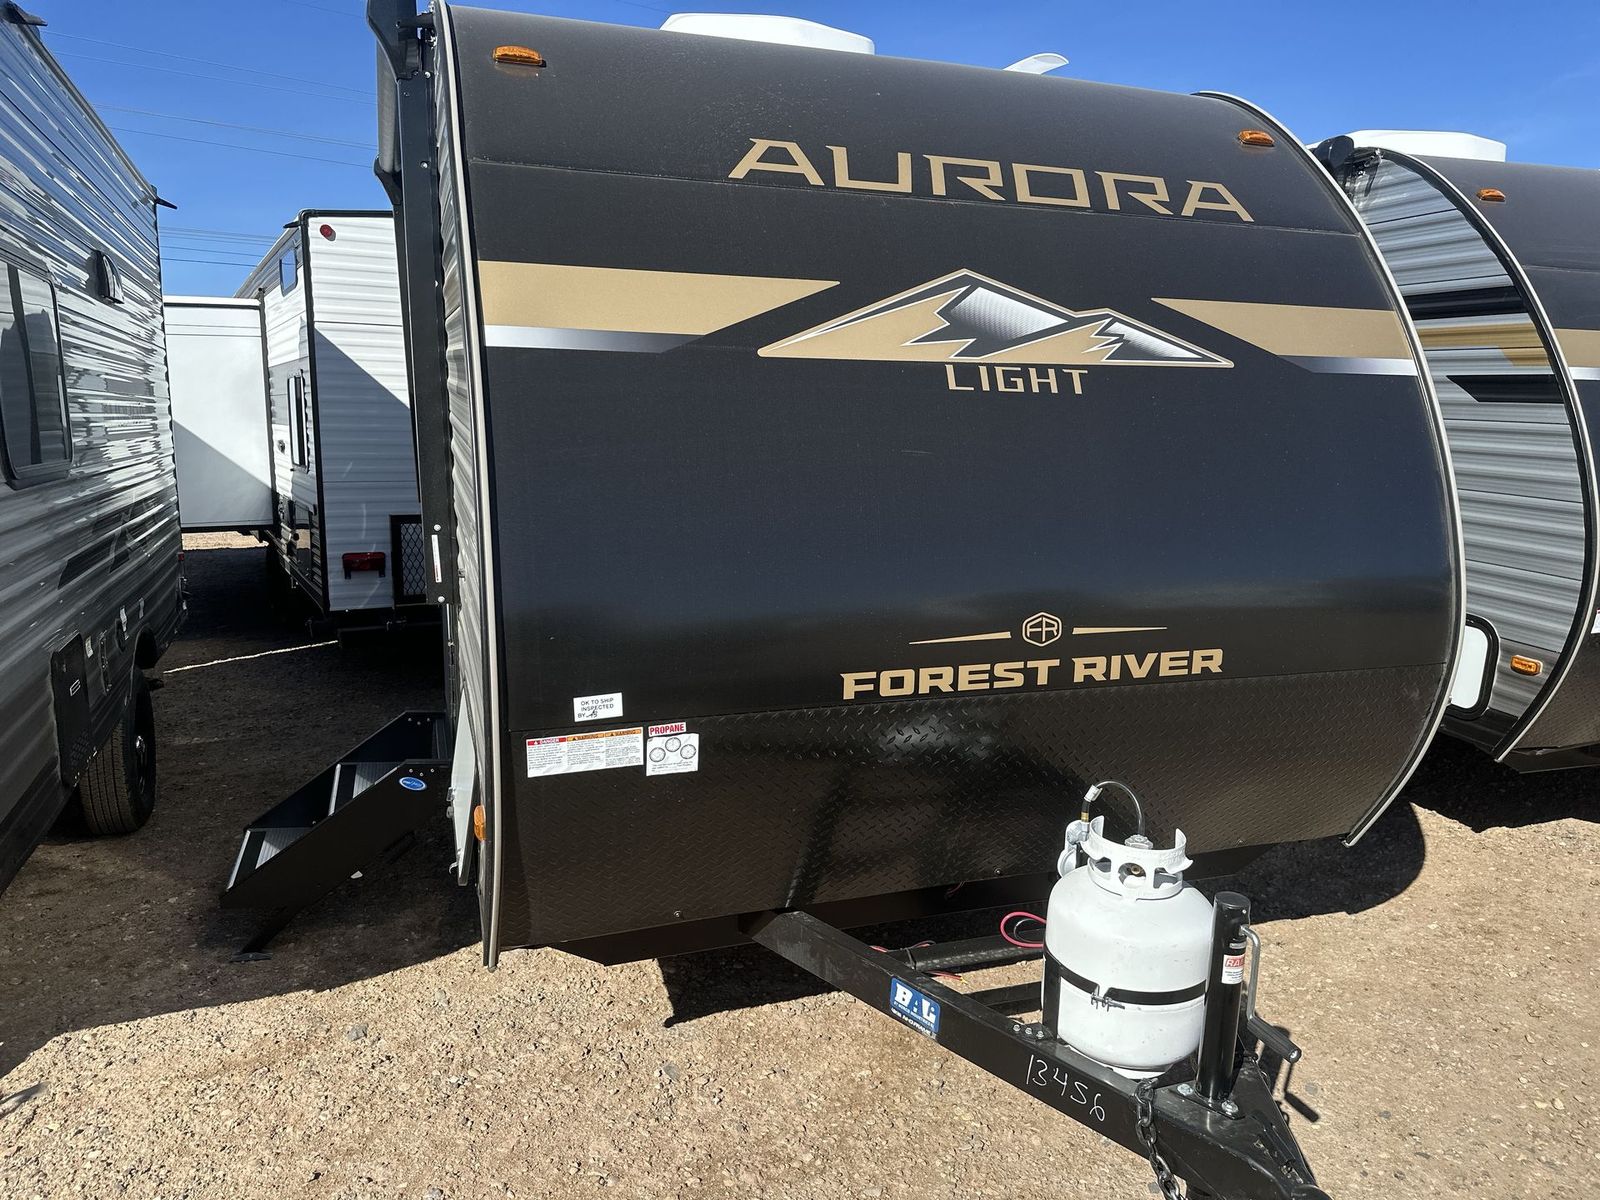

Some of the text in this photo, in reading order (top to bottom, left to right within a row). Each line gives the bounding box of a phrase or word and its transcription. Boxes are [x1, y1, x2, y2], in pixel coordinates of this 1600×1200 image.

[728, 138, 1254, 222] AURORA
[945, 364, 1088, 394] LIGHT
[840, 648, 1223, 700] FOREST RIVER
[581, 703, 614, 712] INSPECTED
[649, 723, 685, 736] PROPANE
